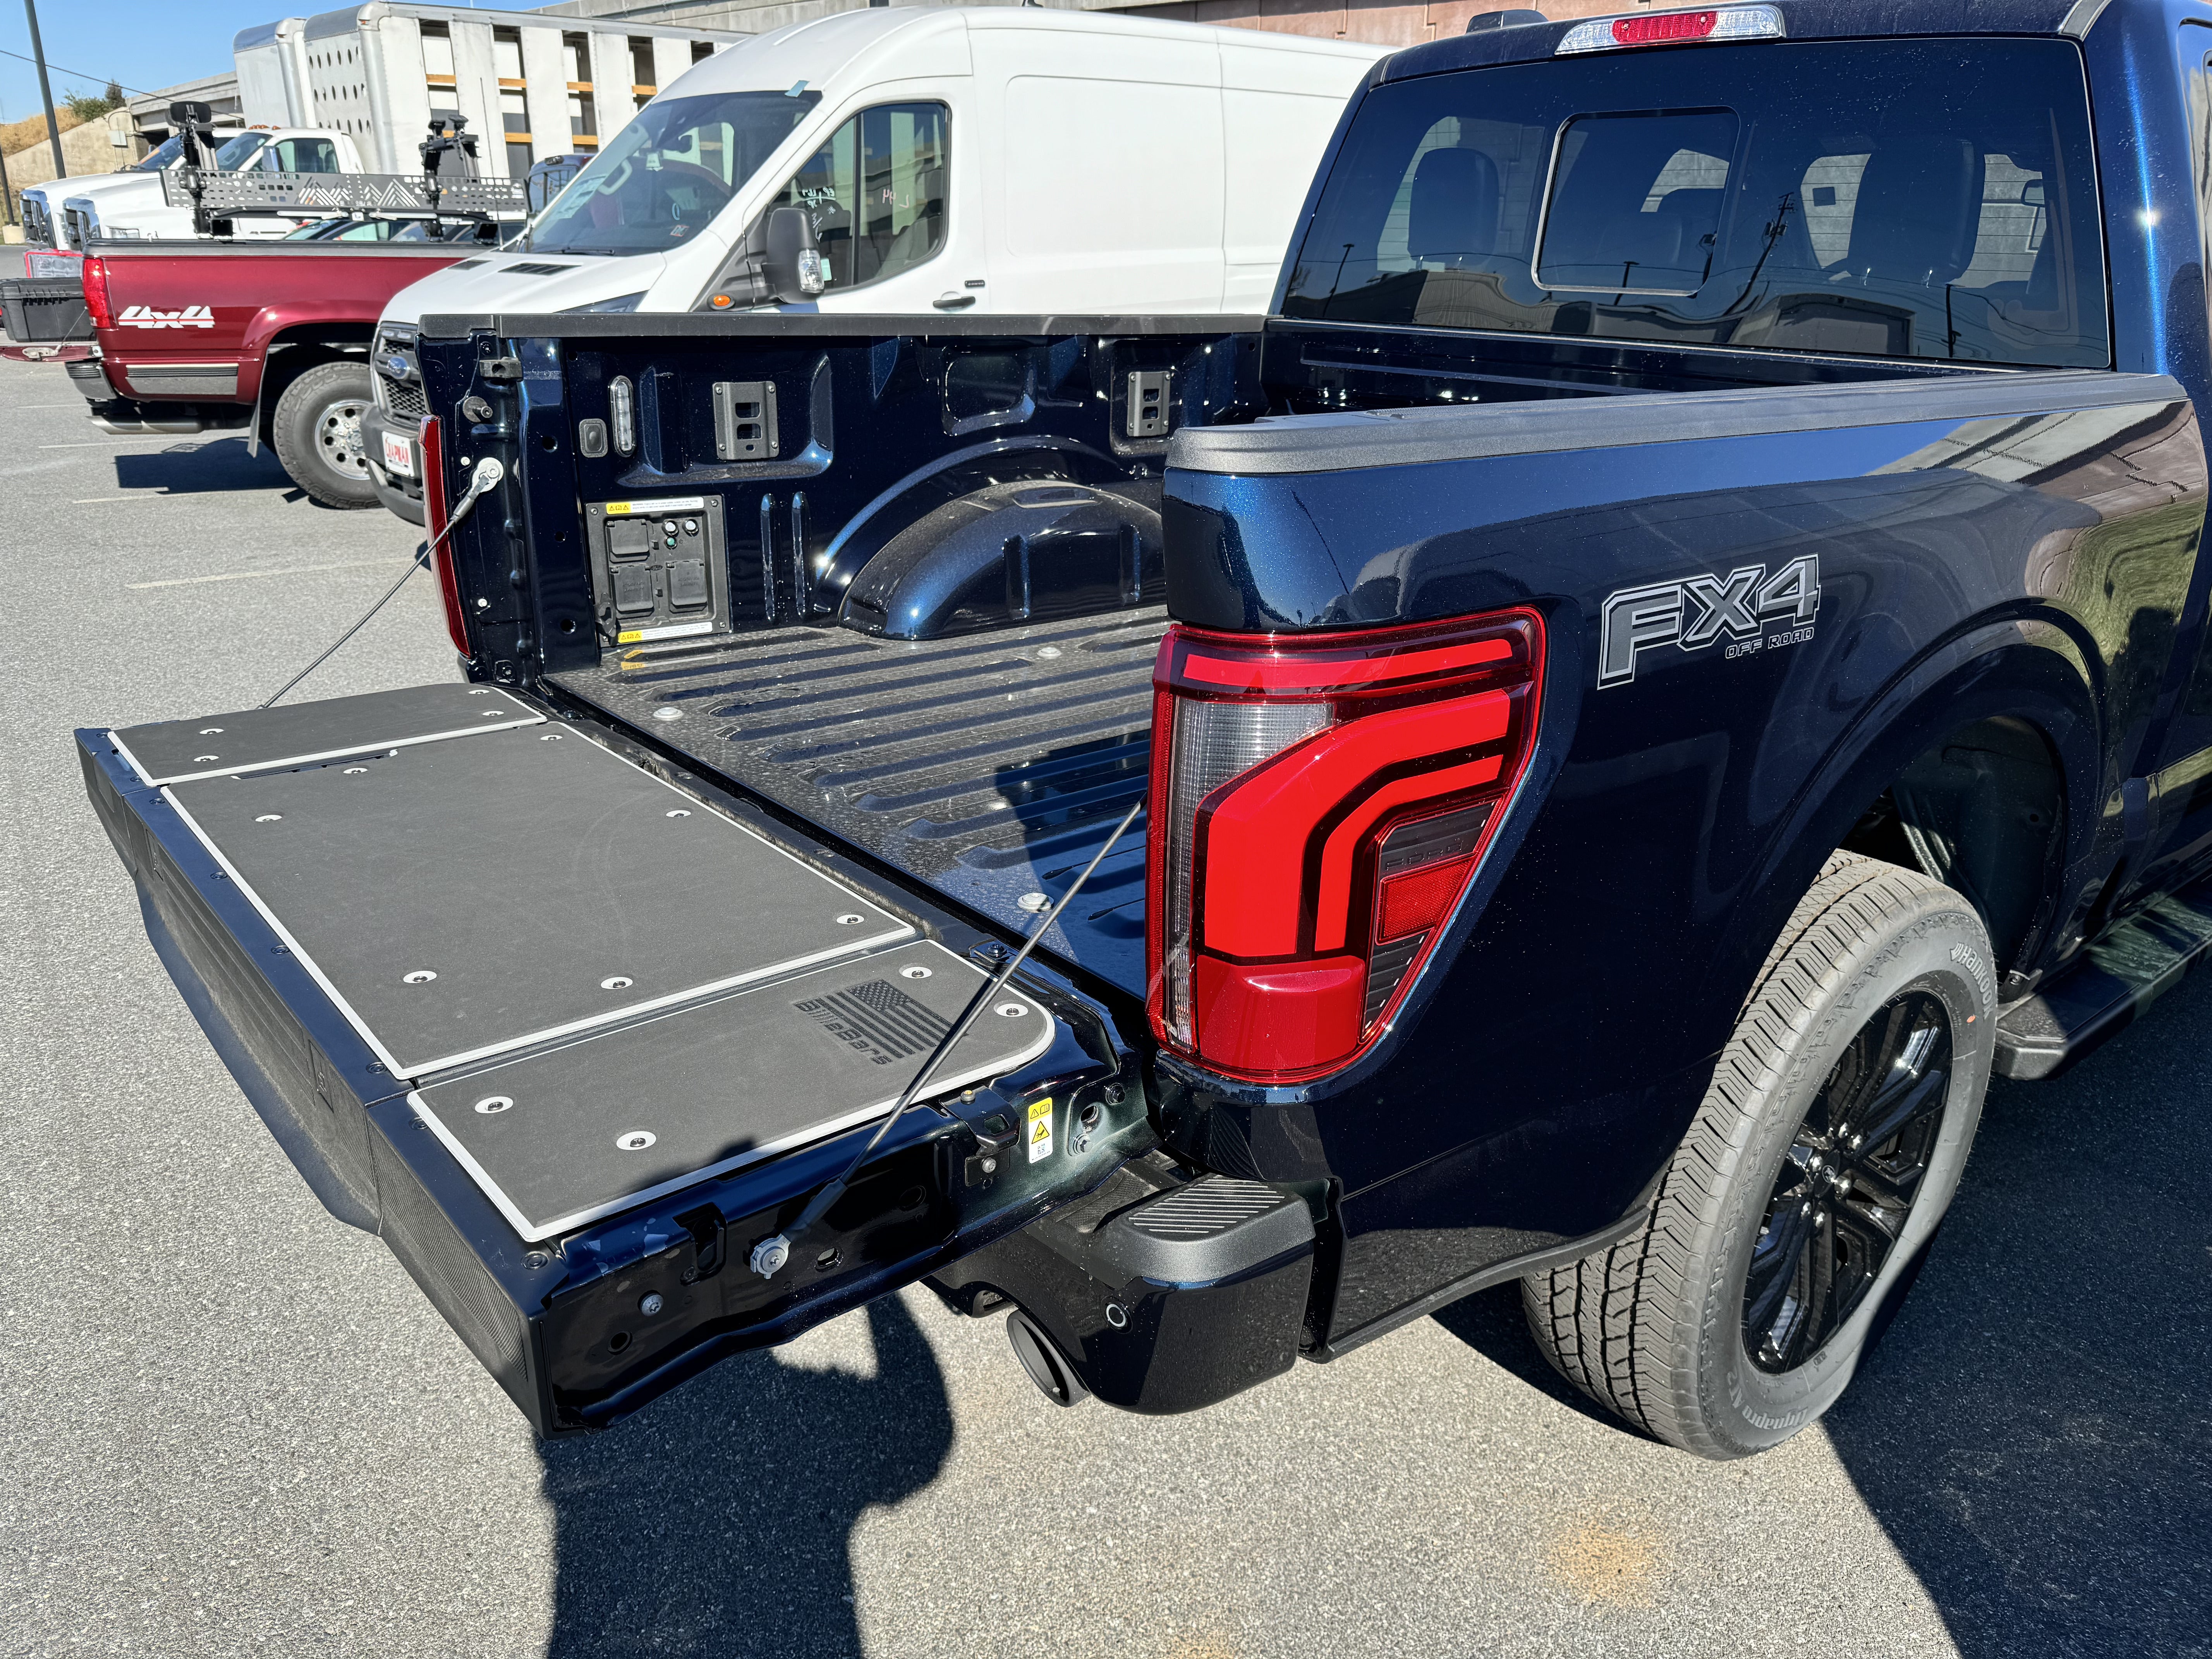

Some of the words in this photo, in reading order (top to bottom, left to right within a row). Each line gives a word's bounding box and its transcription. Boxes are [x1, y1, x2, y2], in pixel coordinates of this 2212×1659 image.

[118, 306, 215, 329] 4x4
[1597, 553, 1821, 690] FX4
[1725, 639, 1762, 659] OFF
[1767, 627, 1814, 649] ROAD
